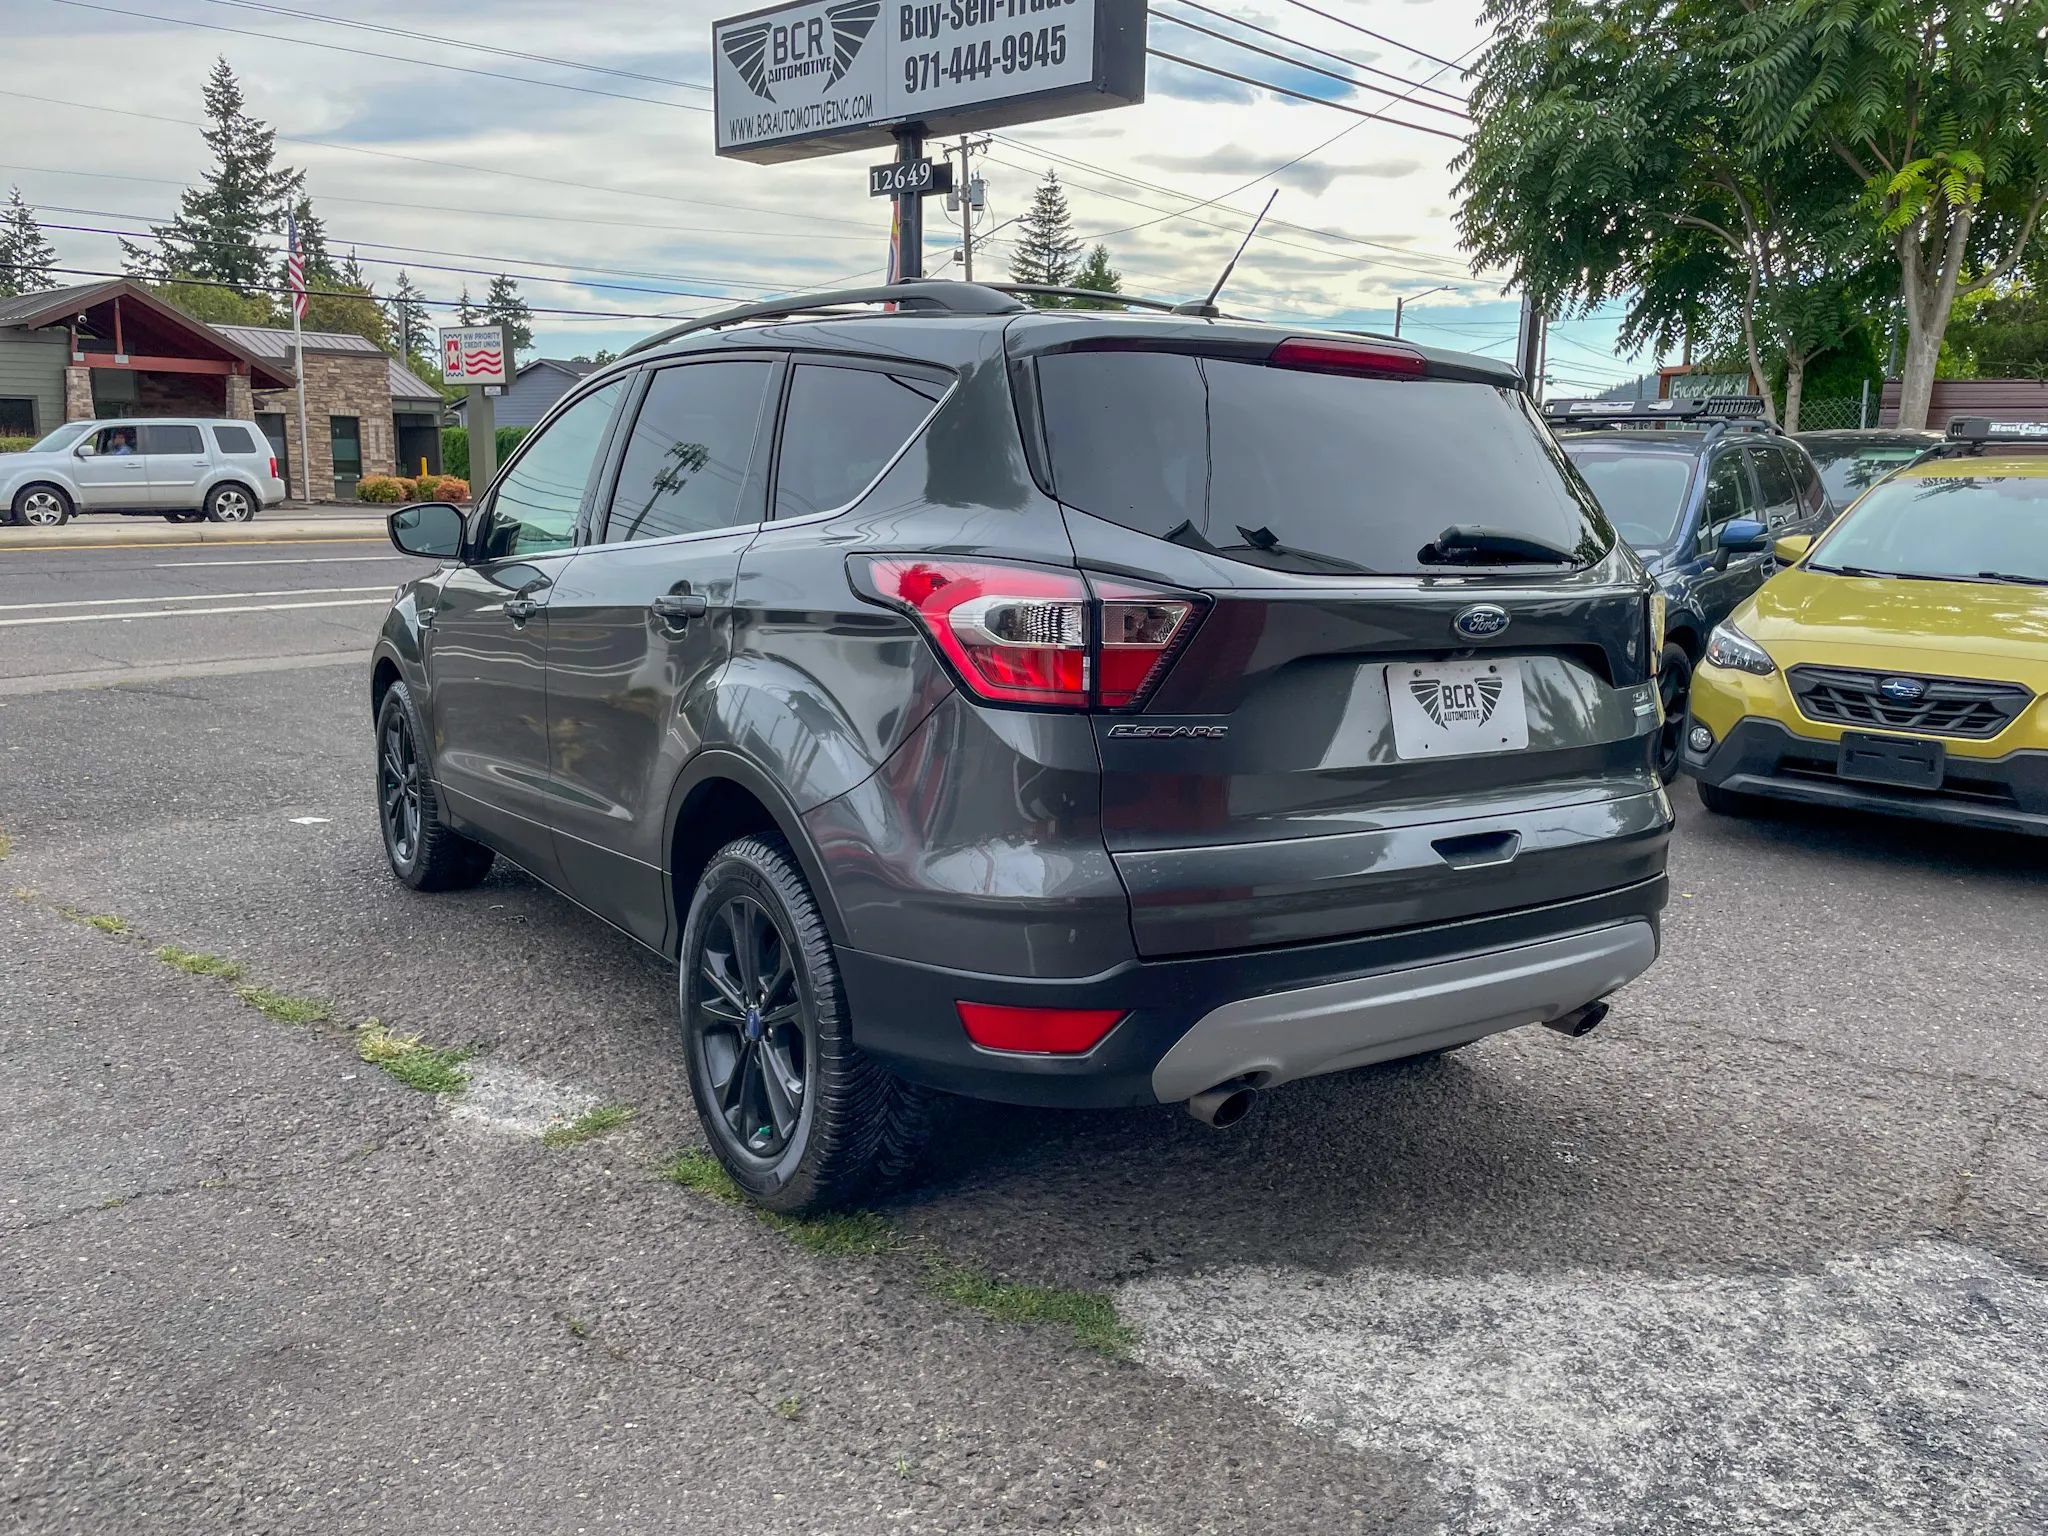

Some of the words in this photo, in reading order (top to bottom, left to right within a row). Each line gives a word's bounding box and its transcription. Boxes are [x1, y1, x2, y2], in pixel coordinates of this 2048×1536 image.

[900, 0, 1076, 42] Buy-Sell-
[773, 16, 824, 66] BCR
[767, 56, 832, 84] AUTOMOTIVE
[904, 24, 1067, 94] 971-444-9945
[729, 93, 874, 142] WWW.BCRAUTOMOTIVEINC.COM
[872, 163, 930, 191] 12649
[1469, 612, 1499, 632] Ford
[1442, 684, 1477, 709] BCR
[1443, 709, 1481, 722] AUTOMOTIVE
[1107, 724, 1229, 739] ESCAPE
